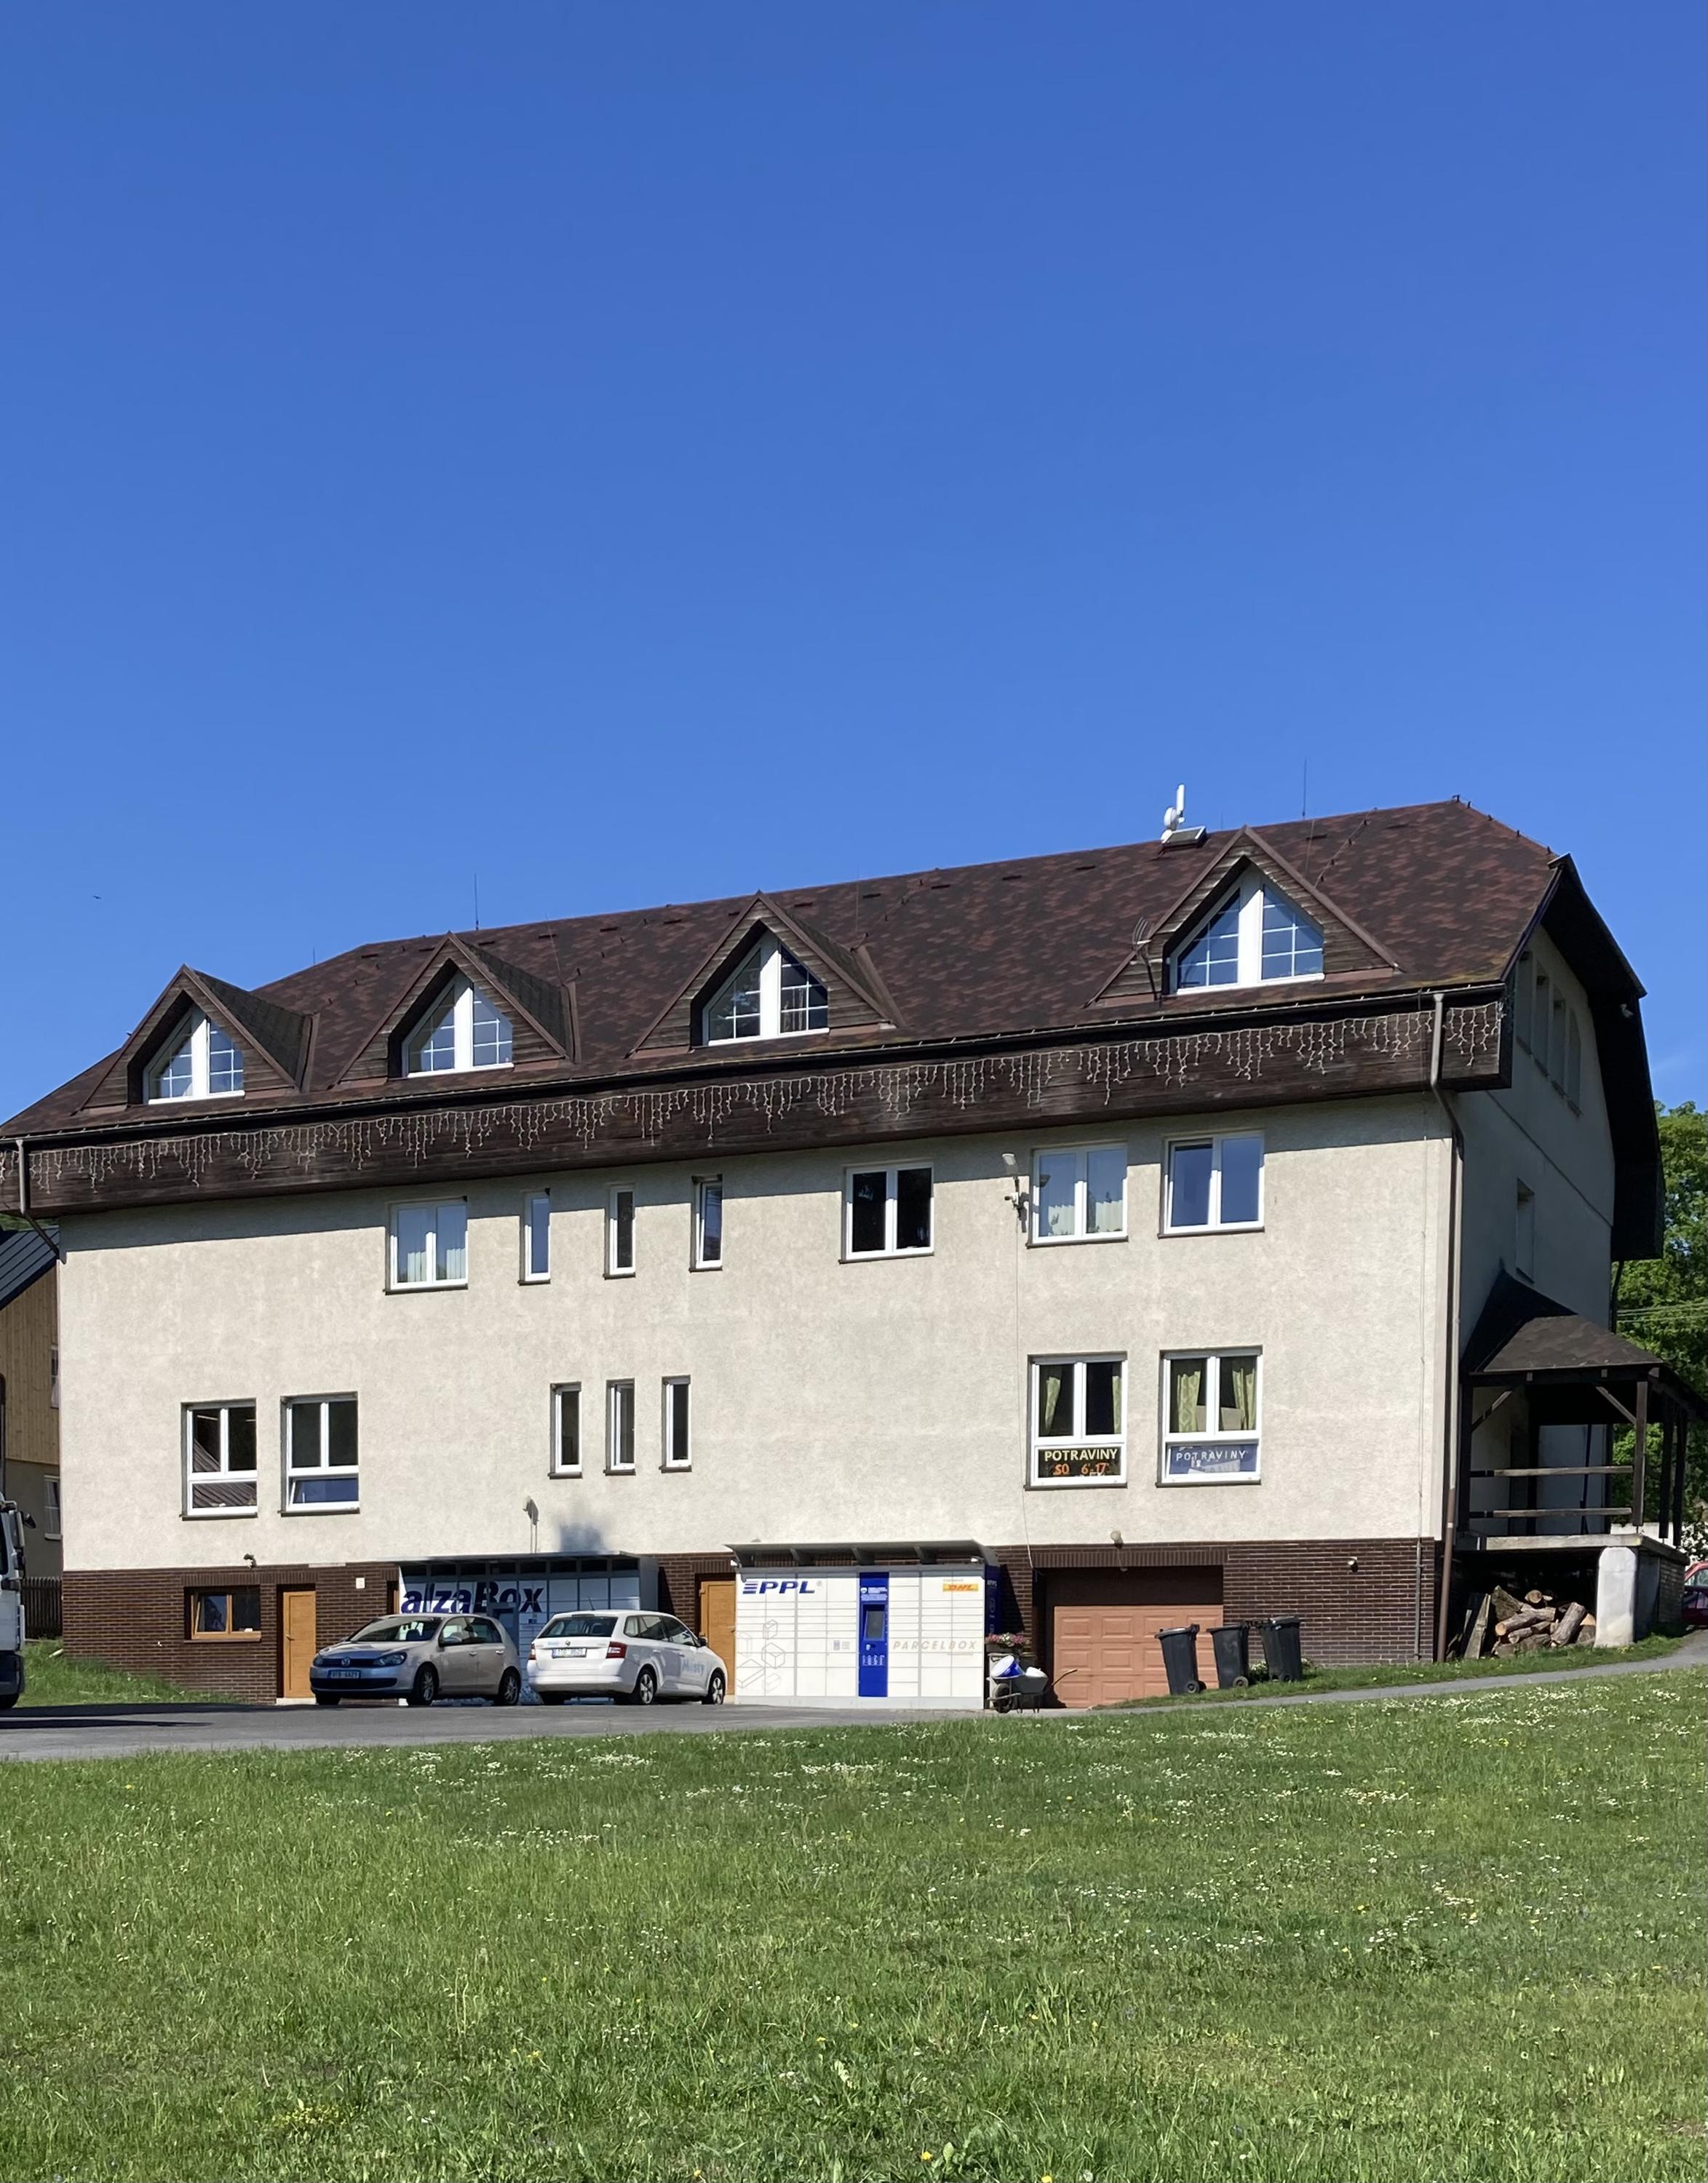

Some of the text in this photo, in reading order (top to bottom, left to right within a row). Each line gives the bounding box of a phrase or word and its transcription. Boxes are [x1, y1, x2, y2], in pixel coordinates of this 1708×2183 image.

[1044, 1448, 1118, 1462] POTRAVINY
[1176, 1450, 1246, 1462] POTRAVINY
[401, 1581, 544, 1613] alzaBox
[893, 1641, 977, 1650] PARCELBOX
